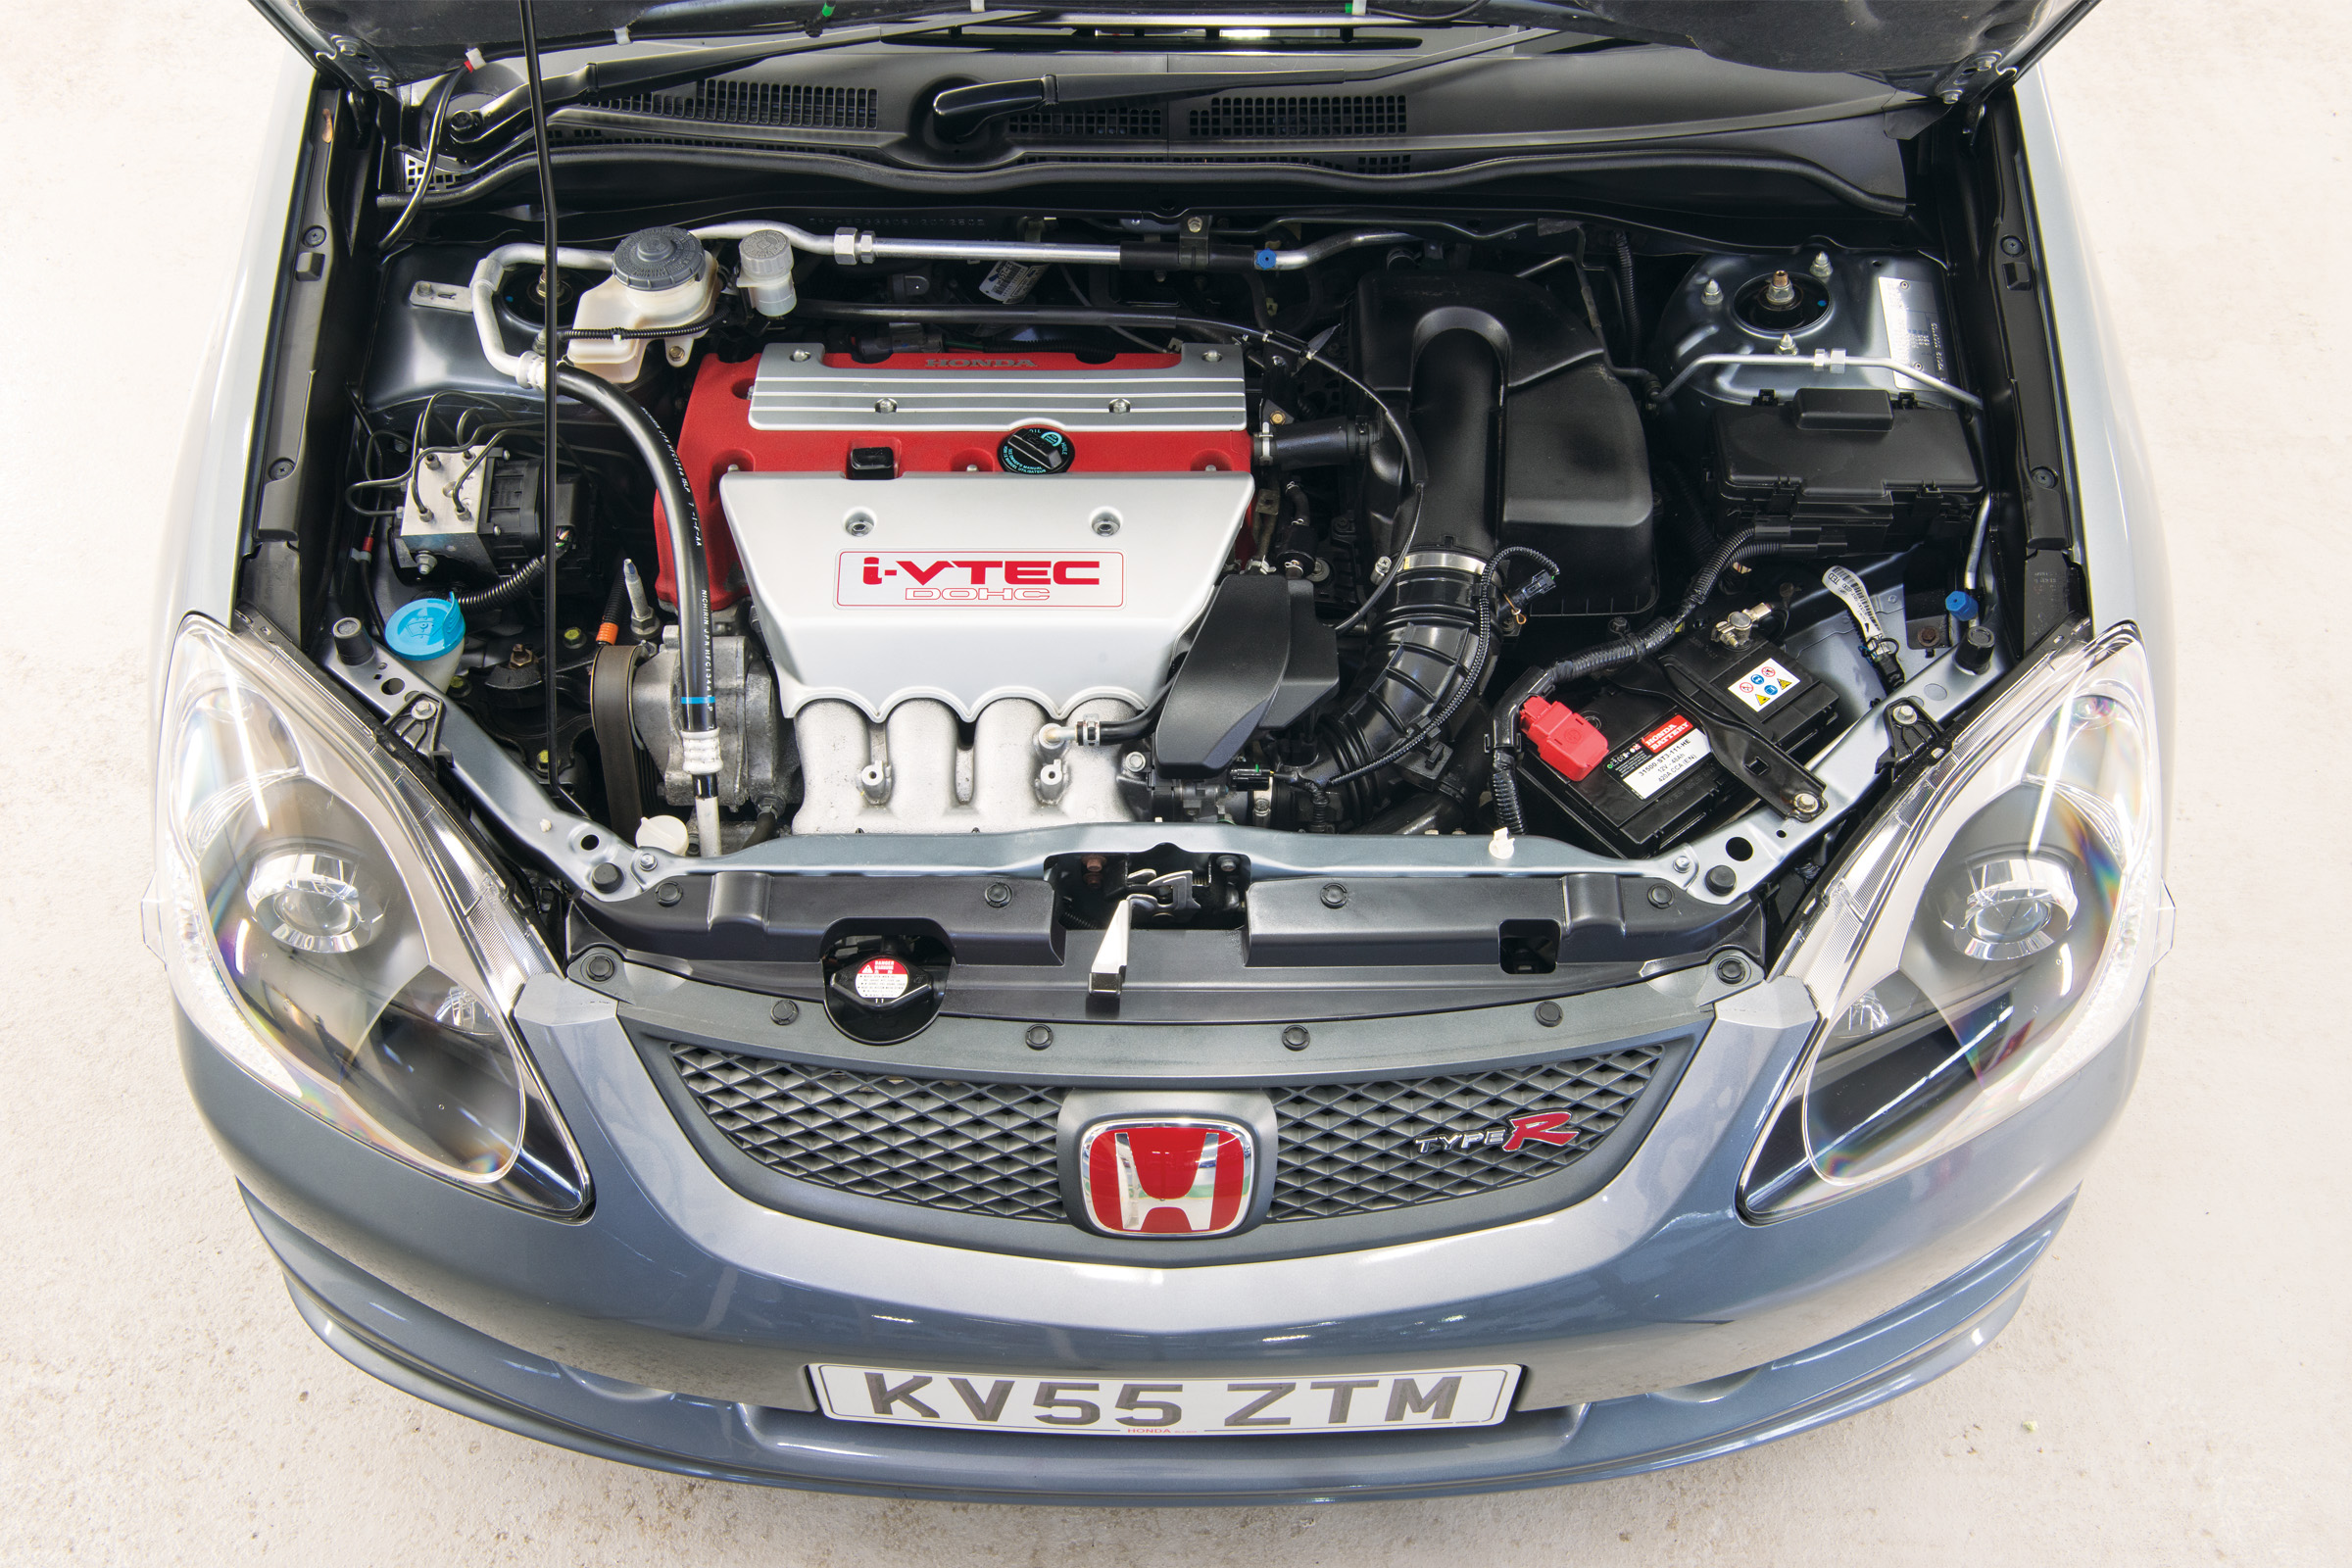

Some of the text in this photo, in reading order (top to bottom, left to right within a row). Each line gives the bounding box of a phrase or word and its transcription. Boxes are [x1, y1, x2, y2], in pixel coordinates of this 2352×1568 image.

[925, 359, 1037, 368] HONDA
[862, 557, 1101, 586] i-VTEC
[905, 587, 1051, 601] DOHC
[1644, 723, 1678, 747] HONDA
[1650, 721, 1690, 751] BATTERY
[1657, 764, 1668, 773] 12V
[1671, 763, 1684, 773] CCA
[1683, 754, 1697, 766] (EN)
[1414, 1107, 1581, 1153] TYPE R
[862, 1371, 1463, 1427] KV55 ZTM
